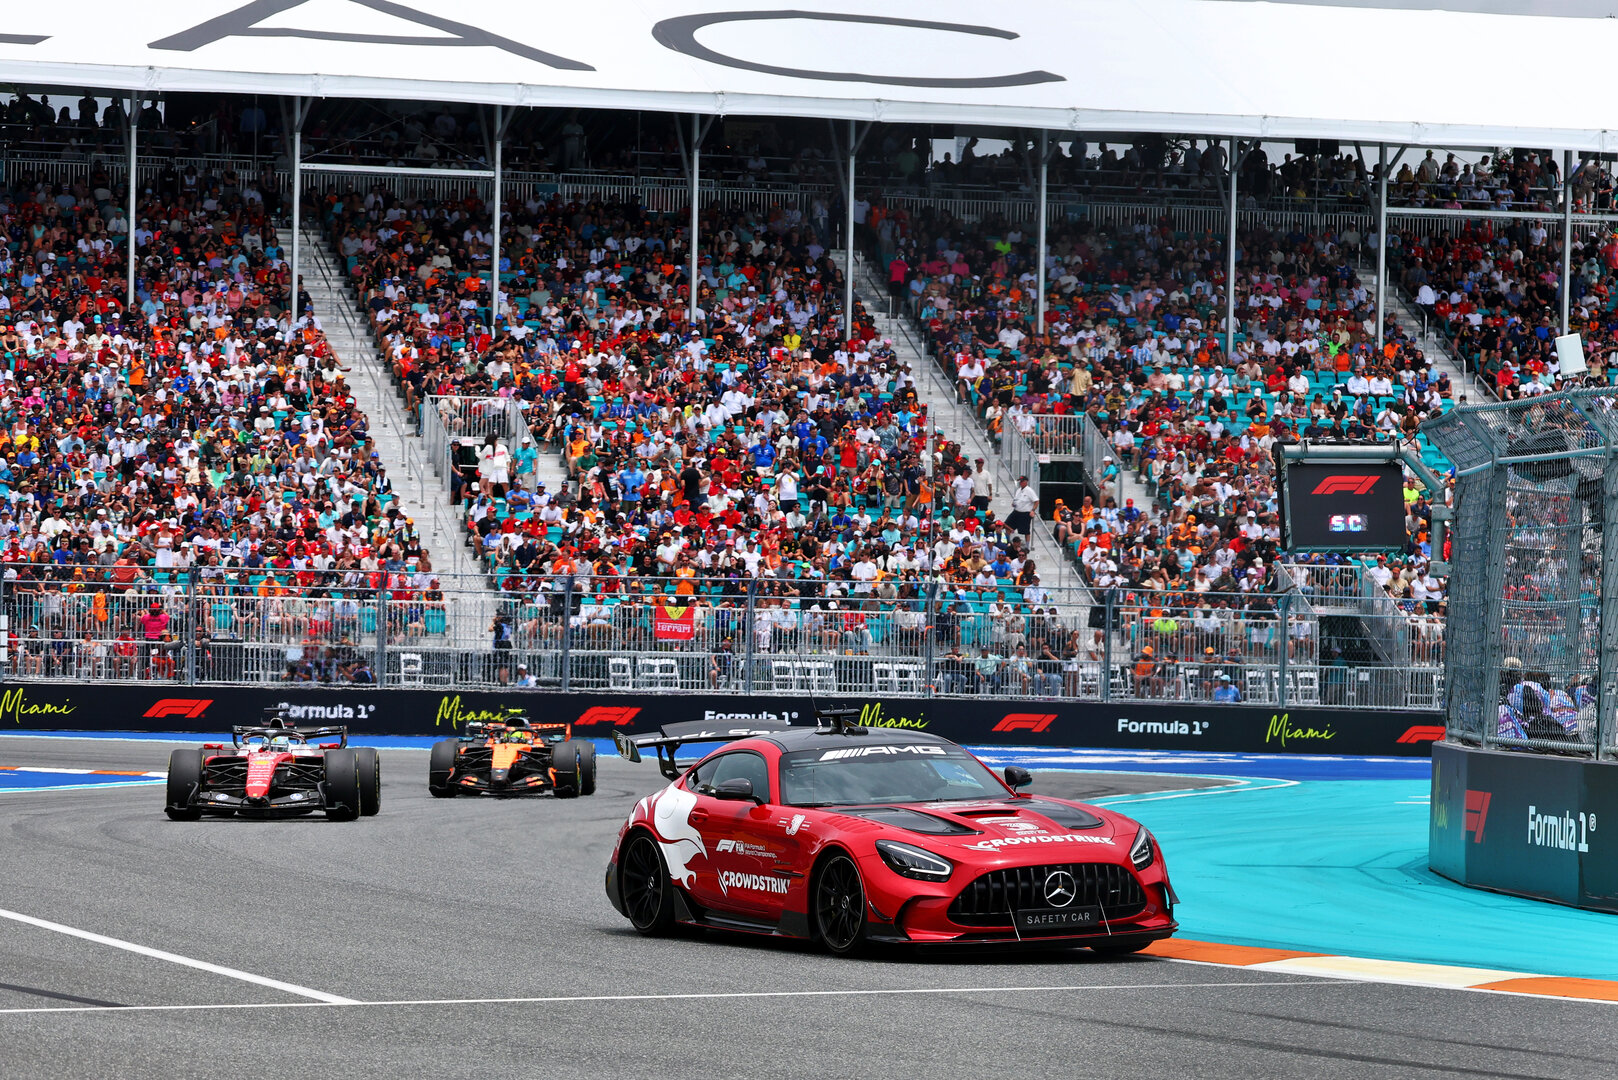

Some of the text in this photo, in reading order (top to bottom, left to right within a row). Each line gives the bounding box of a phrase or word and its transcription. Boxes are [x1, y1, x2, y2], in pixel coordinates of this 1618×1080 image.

[1331, 515, 1361, 531] SC
[657, 622, 691, 633] Ferrari
[0, 688, 77, 723] Miami
[278, 702, 354, 719] Formula
[436, 695, 508, 730] Miami
[858, 702, 931, 728] Miami
[1117, 718, 1189, 735] Formula
[1265, 713, 1337, 747] Miami
[1527, 805, 1576, 851] Formula
[977, 834, 1116, 849] CROWDSTRIKE
[723, 871, 790, 893] CROWDSTRIK
[1027, 912, 1090, 925] SAFETY CAR
